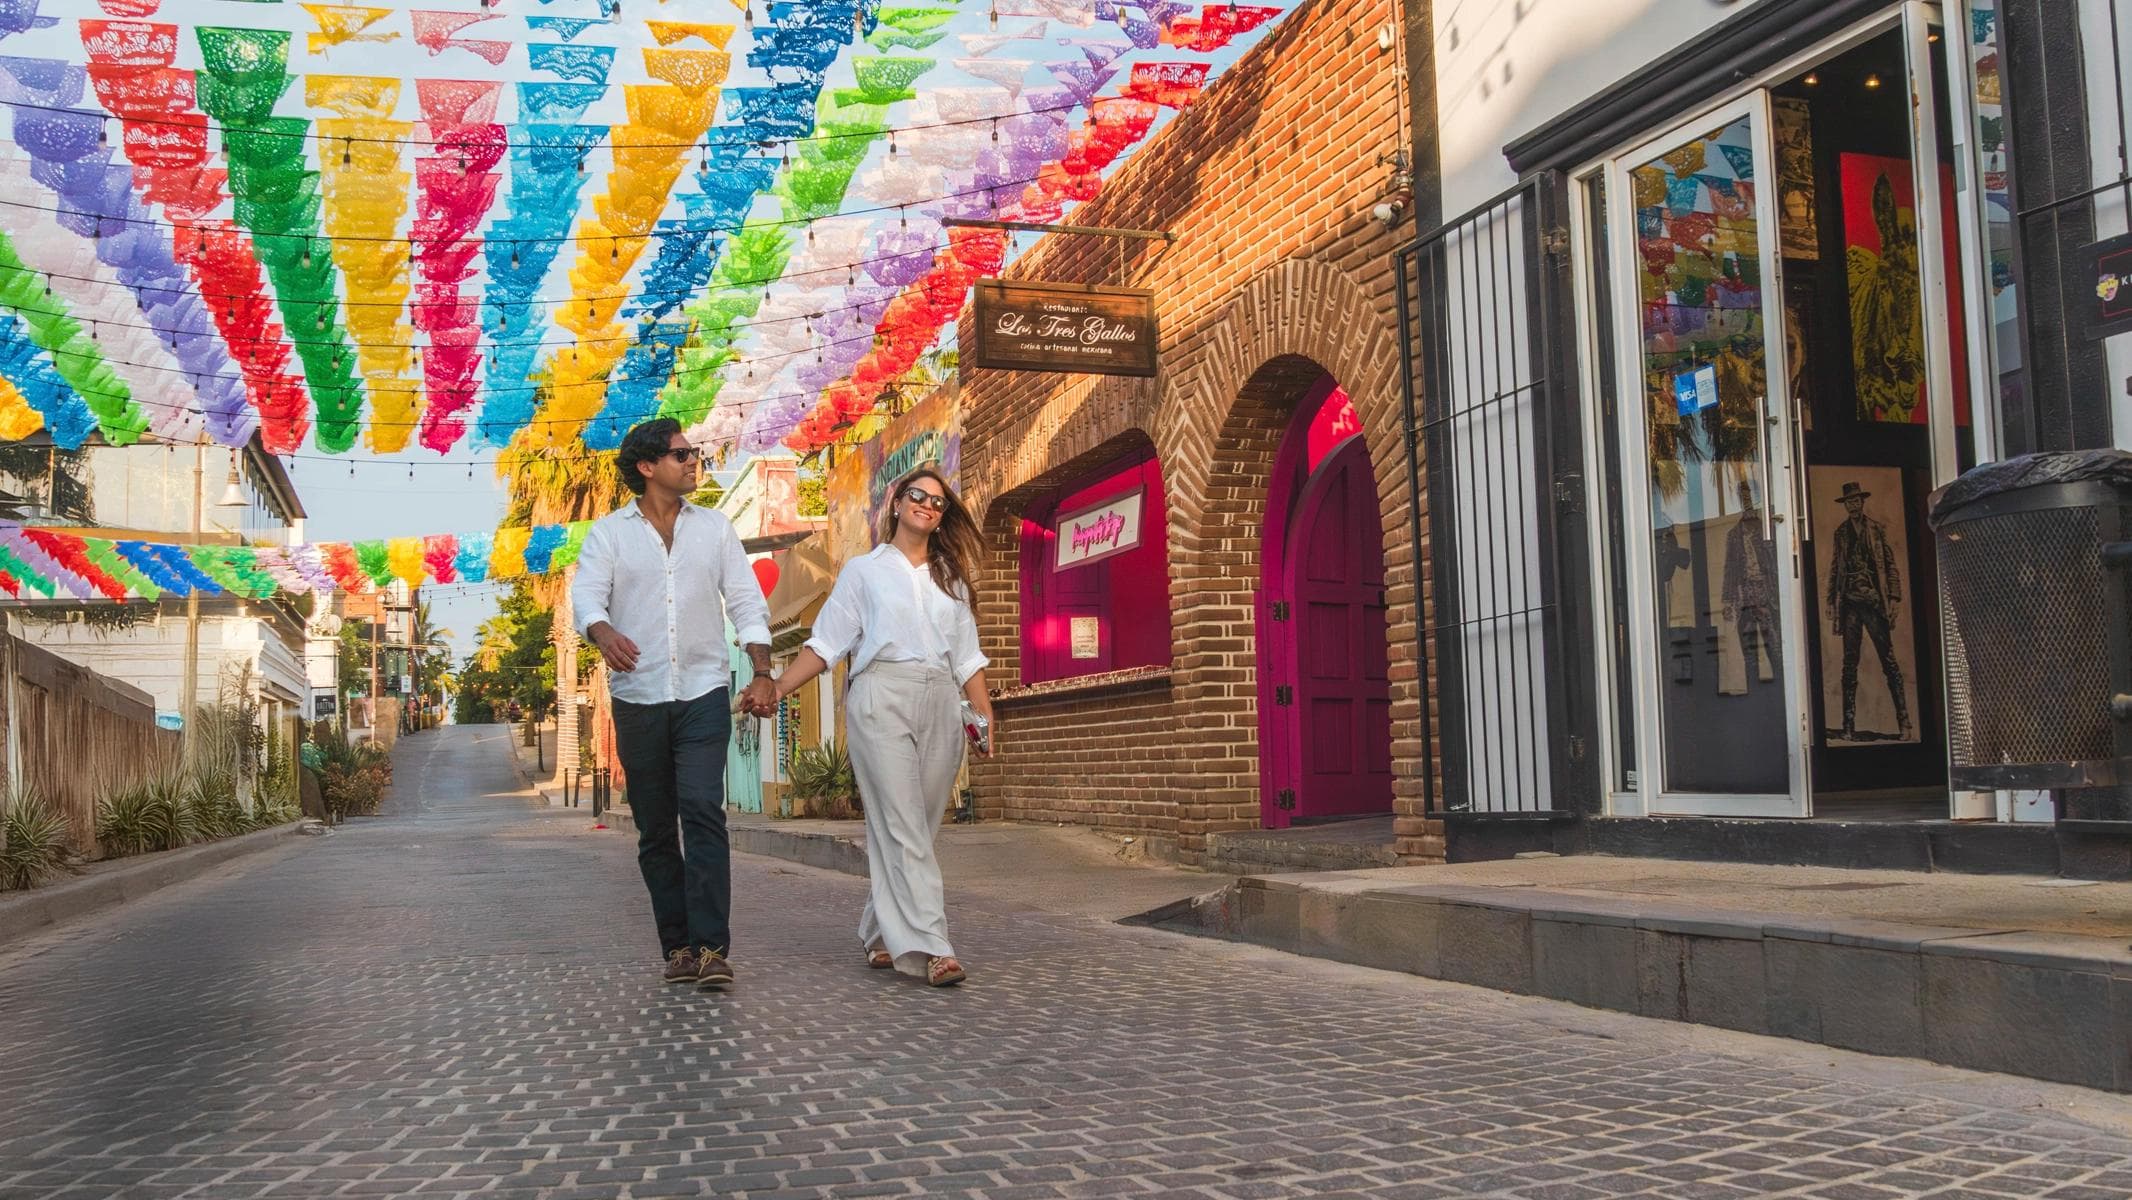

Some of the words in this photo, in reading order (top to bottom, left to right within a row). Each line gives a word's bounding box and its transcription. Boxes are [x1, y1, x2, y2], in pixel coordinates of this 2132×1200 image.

[995, 312, 1032, 336] Los
[1036, 315, 1077, 338] Tres
[1080, 316, 1136, 345] Gallos
[1044, 343, 1078, 352] artesanal
[1680, 389, 1697, 402] VISA
[877, 445, 908, 491] INDIAN
